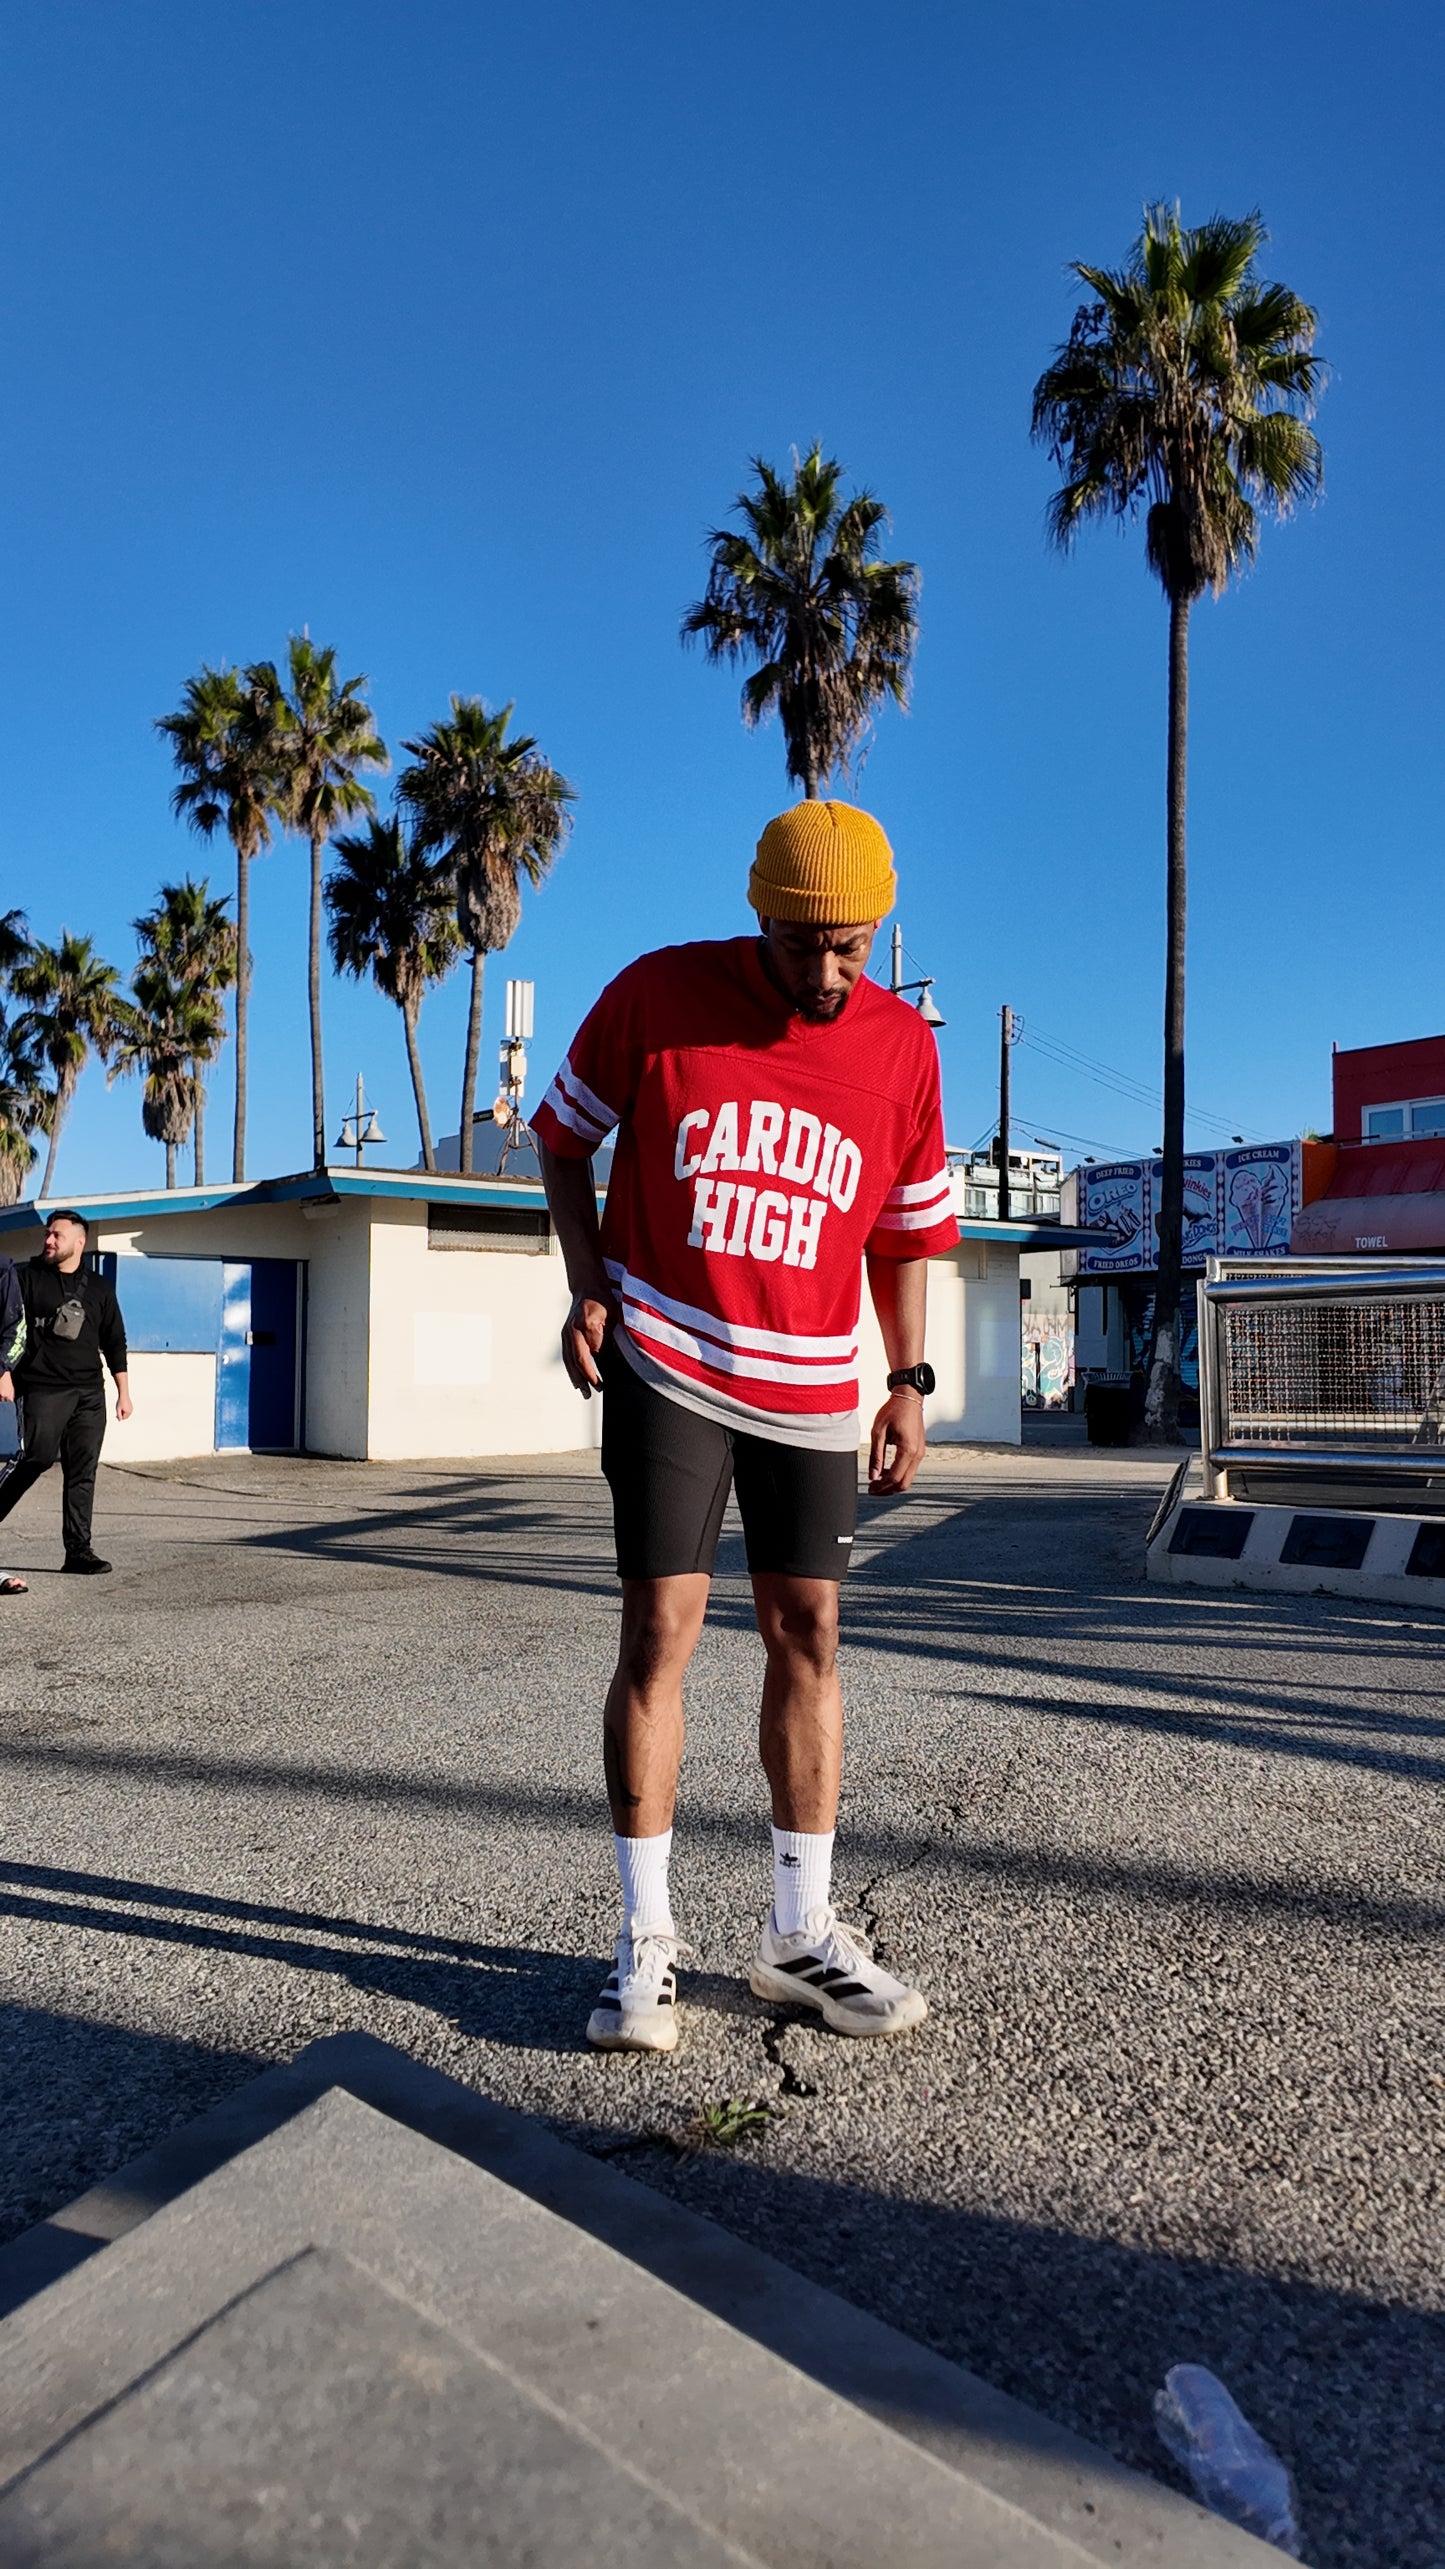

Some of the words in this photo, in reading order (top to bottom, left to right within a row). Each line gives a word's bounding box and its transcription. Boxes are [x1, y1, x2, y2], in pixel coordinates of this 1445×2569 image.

[674, 1100, 863, 1213] CARDIO
[1238, 1152, 1251, 1163] ICE
[1252, 1149, 1280, 1159] CREAM
[1096, 1168, 1112, 1179] DEEP
[1113, 1167, 1134, 1176] FRIED
[1088, 1183, 1137, 1211] OREO
[687, 1177, 828, 1271] HIGH
[1355, 1236, 1388, 1248] TOWEL
[1094, 1260, 1114, 1269] FRIED
[1115, 1257, 1138, 1269] OREOS
[1182, 1253, 1207, 1264] DONGS
